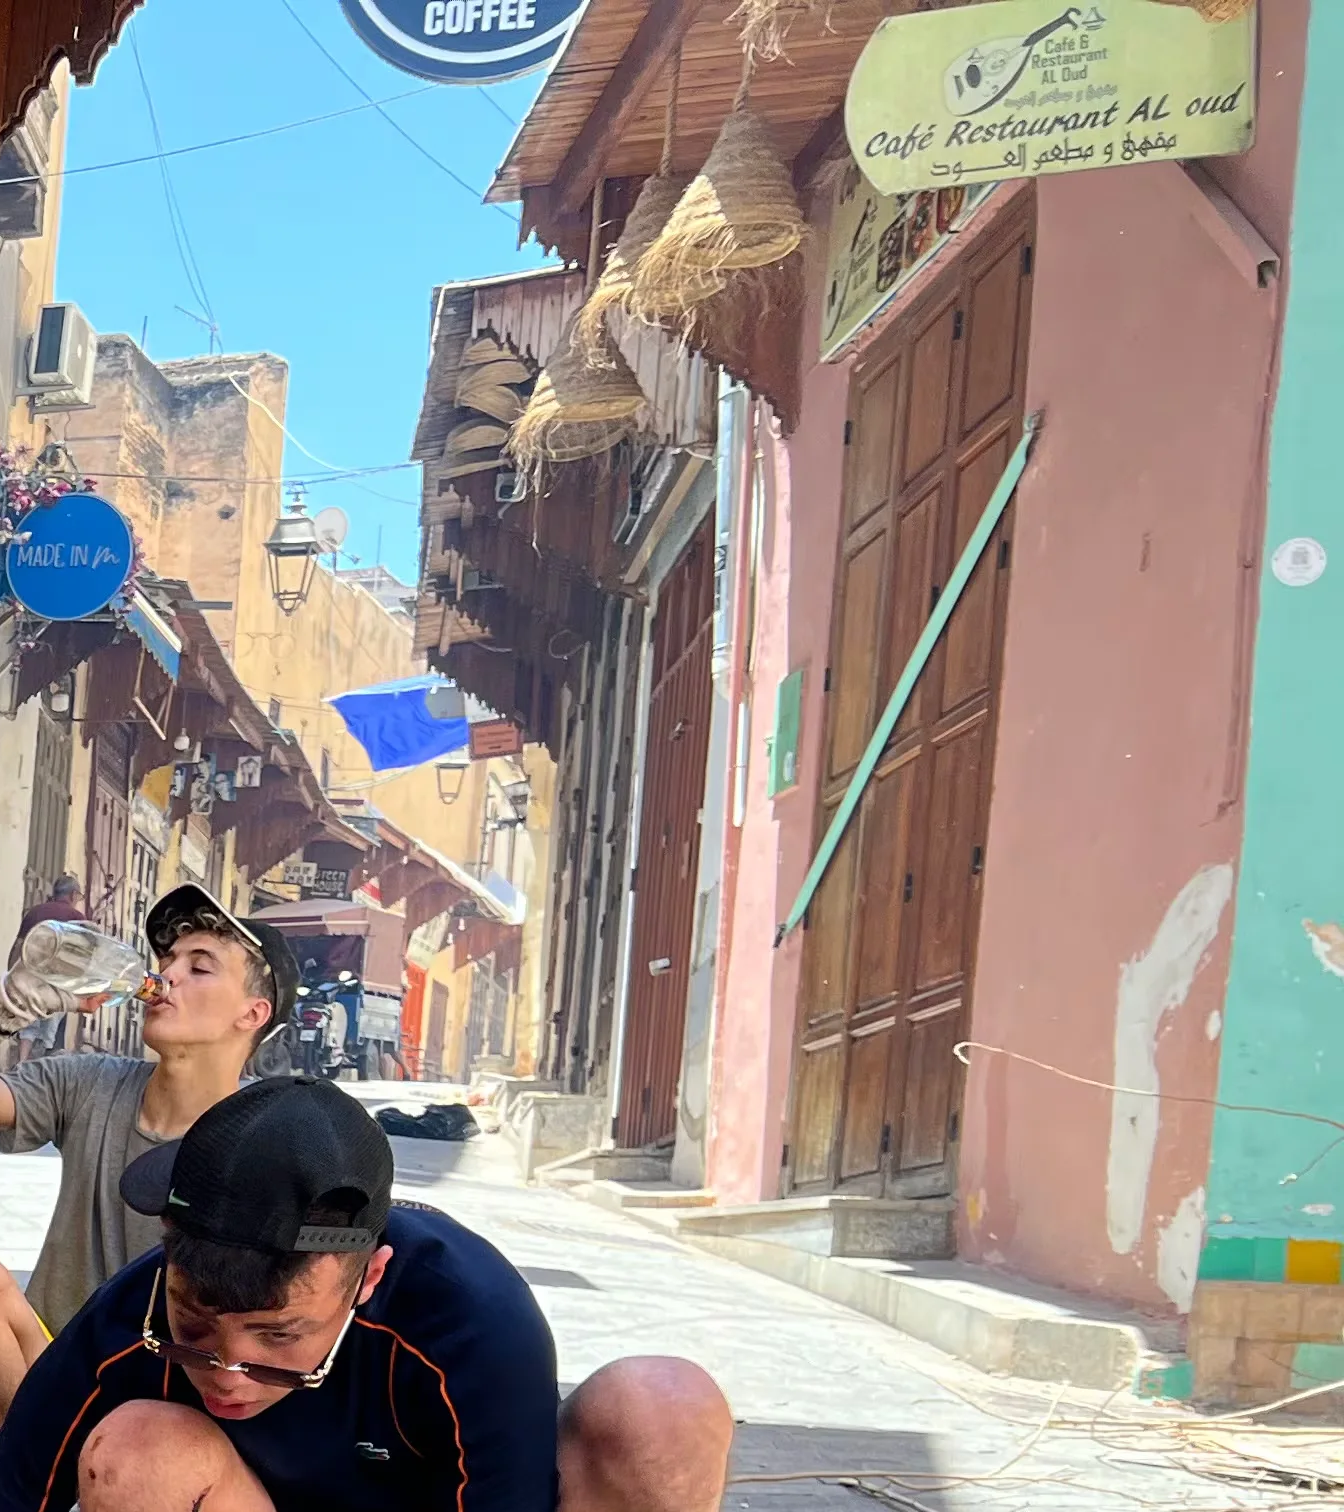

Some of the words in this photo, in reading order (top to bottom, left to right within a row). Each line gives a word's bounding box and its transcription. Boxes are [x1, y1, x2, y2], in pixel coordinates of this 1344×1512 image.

[424, 0, 536, 36] COFFEE
[1031, 48, 1108, 69] Restaurant
[1044, 37, 1075, 55] Café
[1041, 70, 1057, 85] AL
[1062, 65, 1088, 82] Oud
[864, 123, 938, 160] Café
[945, 101, 1120, 148] Restaurant
[1125, 94, 1171, 124] AL
[1185, 81, 1246, 117] oud
[1032, 136, 1094, 170] مطعم
[16, 543, 65, 568] MADE
[69, 543, 89, 567] IN
